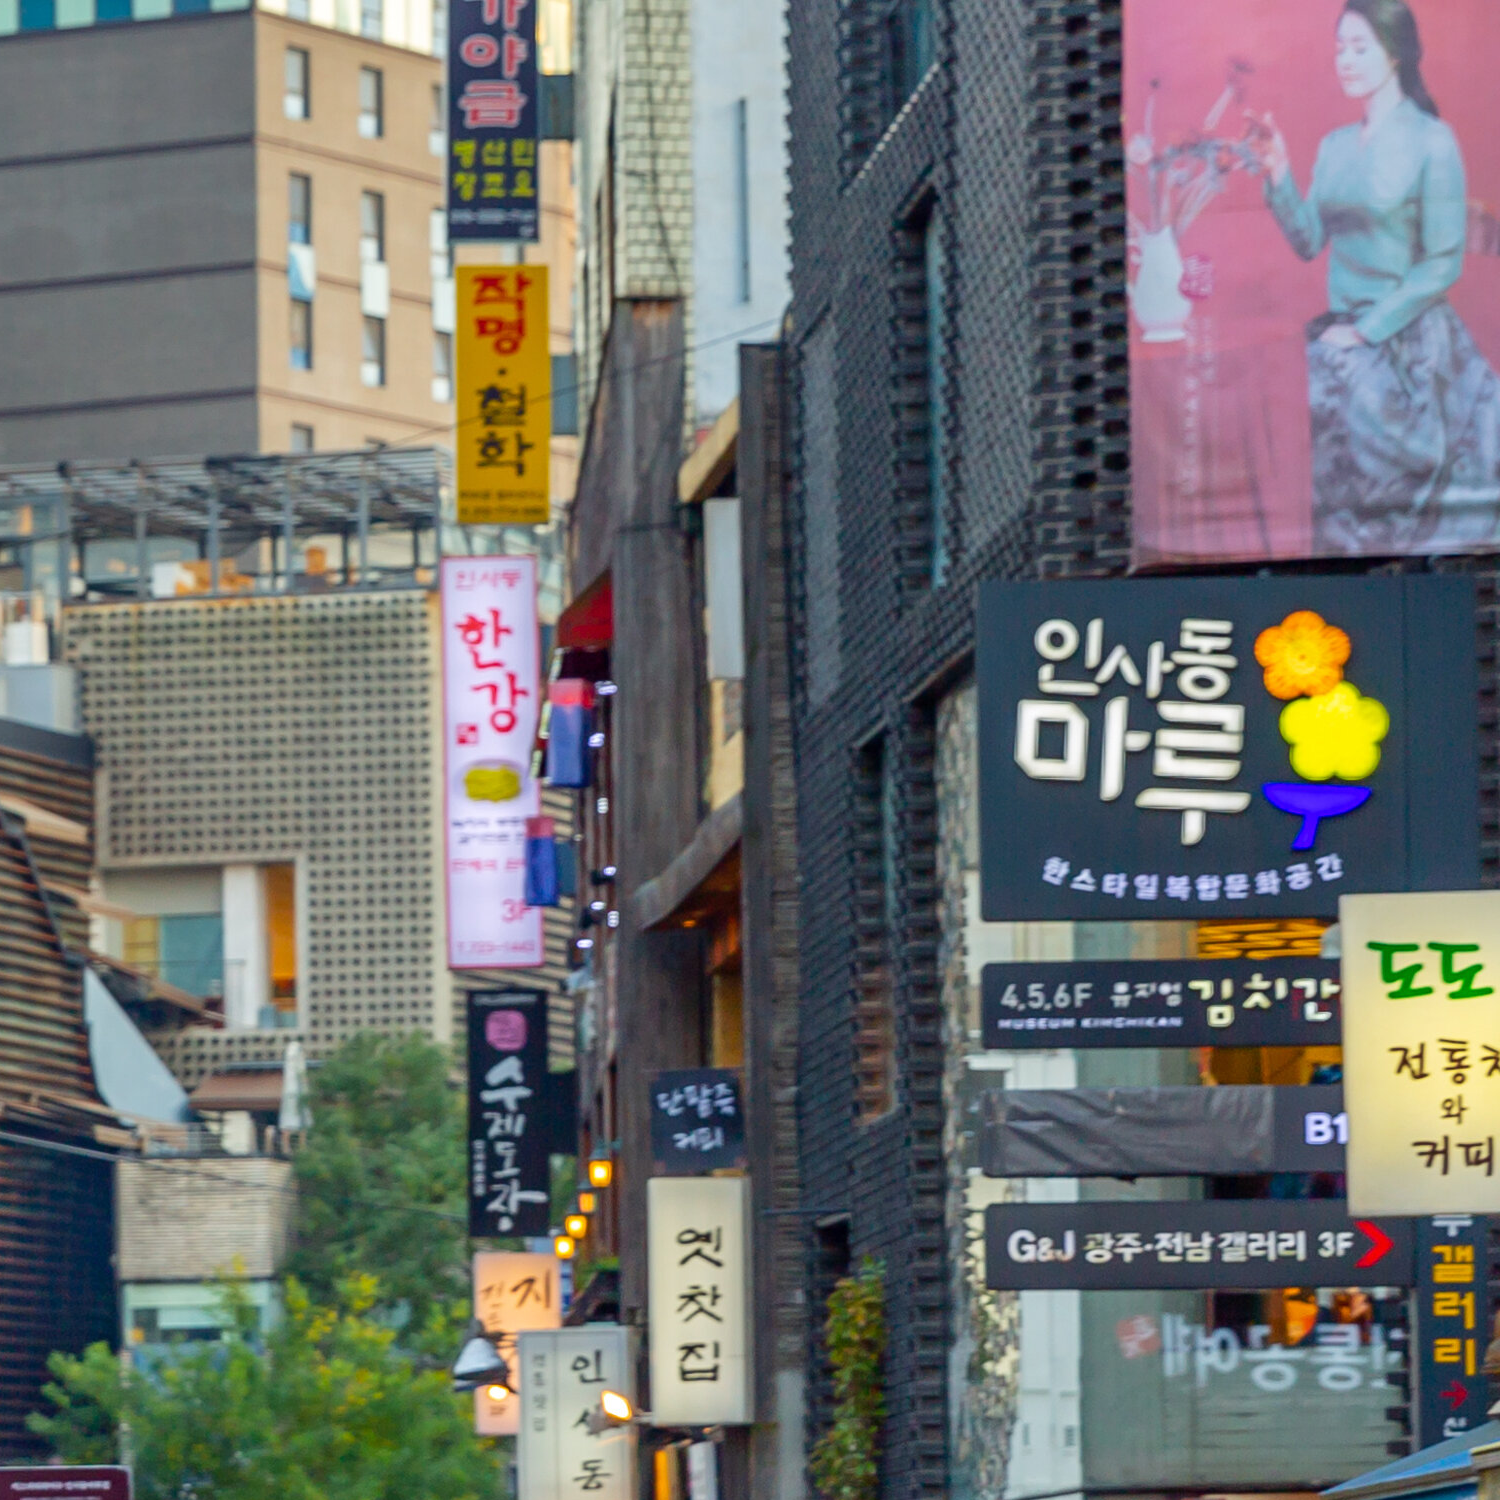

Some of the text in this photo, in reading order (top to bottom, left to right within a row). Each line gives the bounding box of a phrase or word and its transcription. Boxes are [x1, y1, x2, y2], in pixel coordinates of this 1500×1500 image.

[472, 271, 532, 357] 작명
[455, 608, 529, 733] 한강
[1034, 618, 1237, 700] 인사동
[1014, 696, 1251, 845] 마루
[1000, 983, 1092, 1011] 4,5,6F
[1188, 973, 1341, 1028] 김치간
[1366, 941, 1495, 1000] 도도
[997, 1017, 1076, 1029] MUSEUM
[1440, 1094, 1468, 1125] 와
[1411, 1134, 1495, 1178] 커피
[1007, 1229, 1077, 1263] G&J
[1318, 1231, 1355, 1258] 3F
[676, 1226, 724, 1382] 옛찻집
[1431, 1244, 1477, 1377] 갤러리
